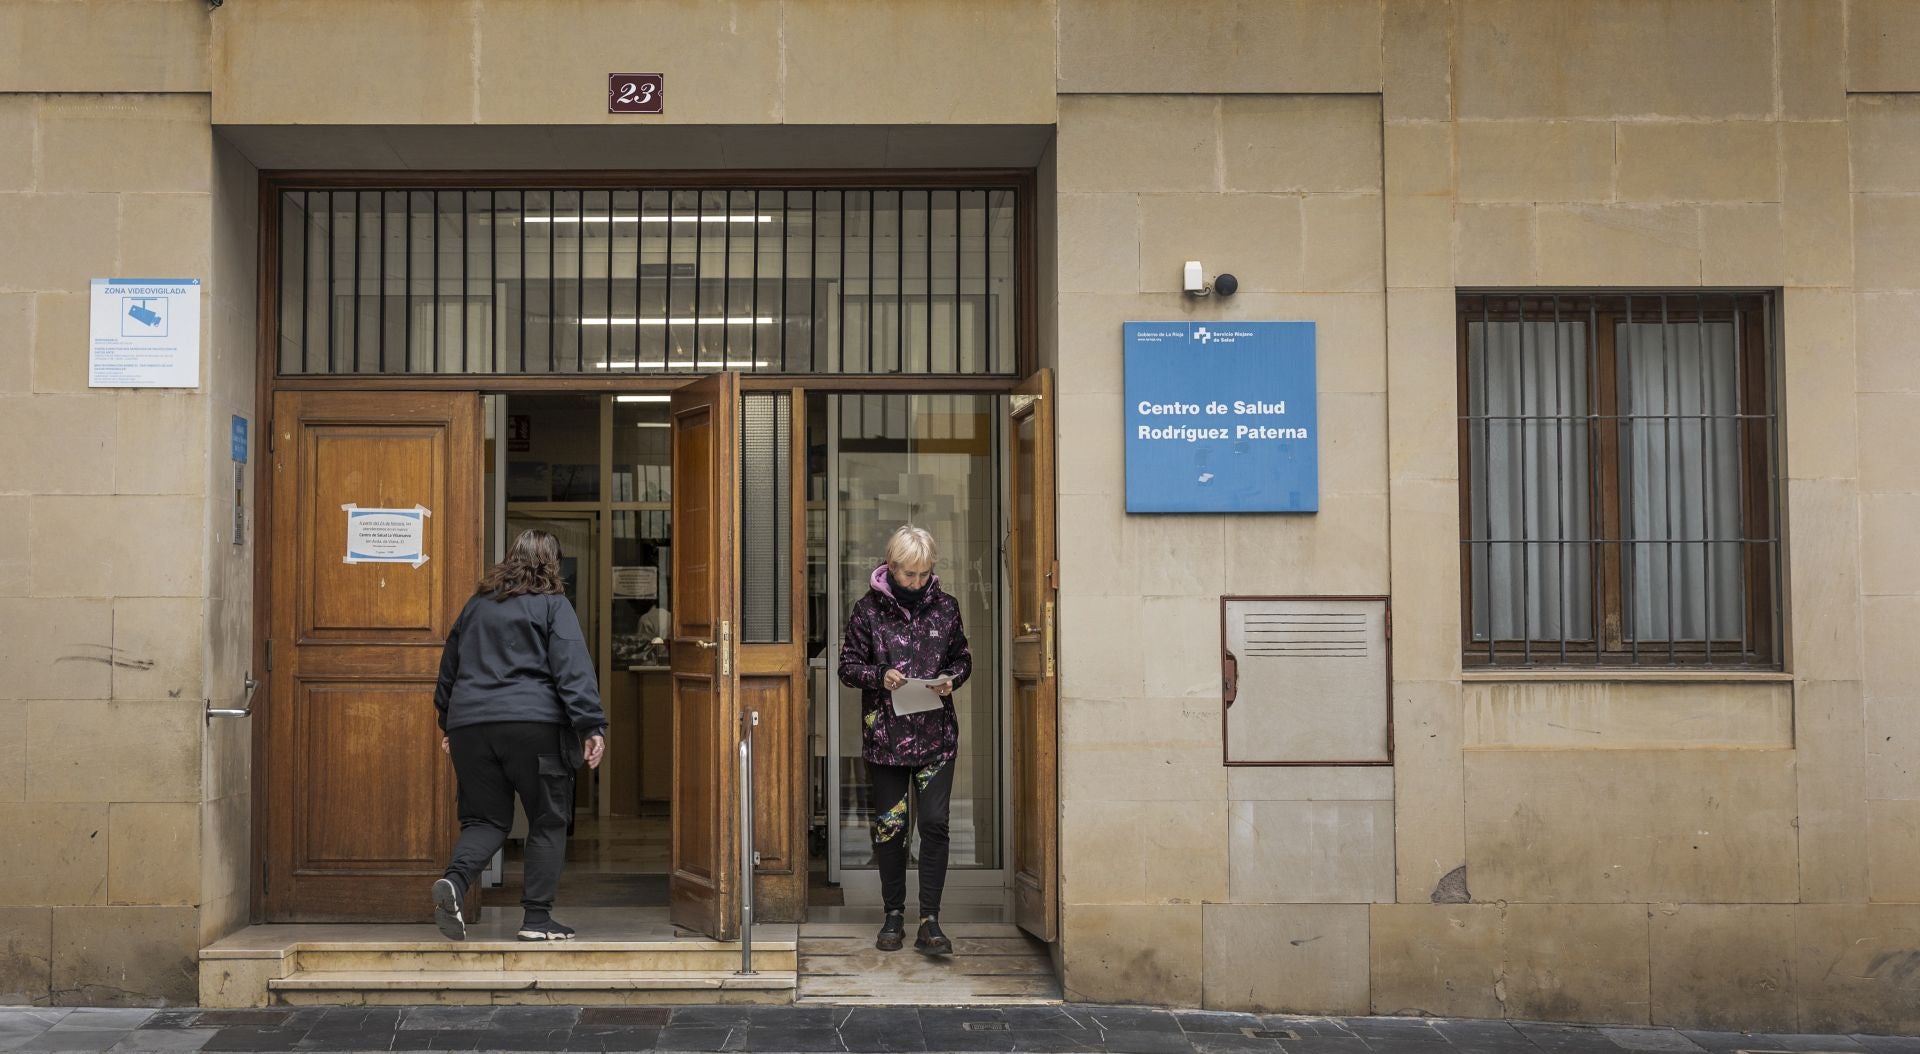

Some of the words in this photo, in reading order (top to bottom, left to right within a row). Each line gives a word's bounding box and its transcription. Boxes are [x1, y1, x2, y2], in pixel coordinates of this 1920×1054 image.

[616, 82, 656, 104] 23
[104, 287, 126, 295] ZONA
[127, 287, 187, 295] VIDEOVIGILADA
[1138, 401, 1200, 415] Centro
[1205, 401, 1228, 415] de
[1233, 400, 1285, 415] Salud
[1138, 425, 1229, 442] Rodríguez
[1236, 425, 1308, 439] Paterna
